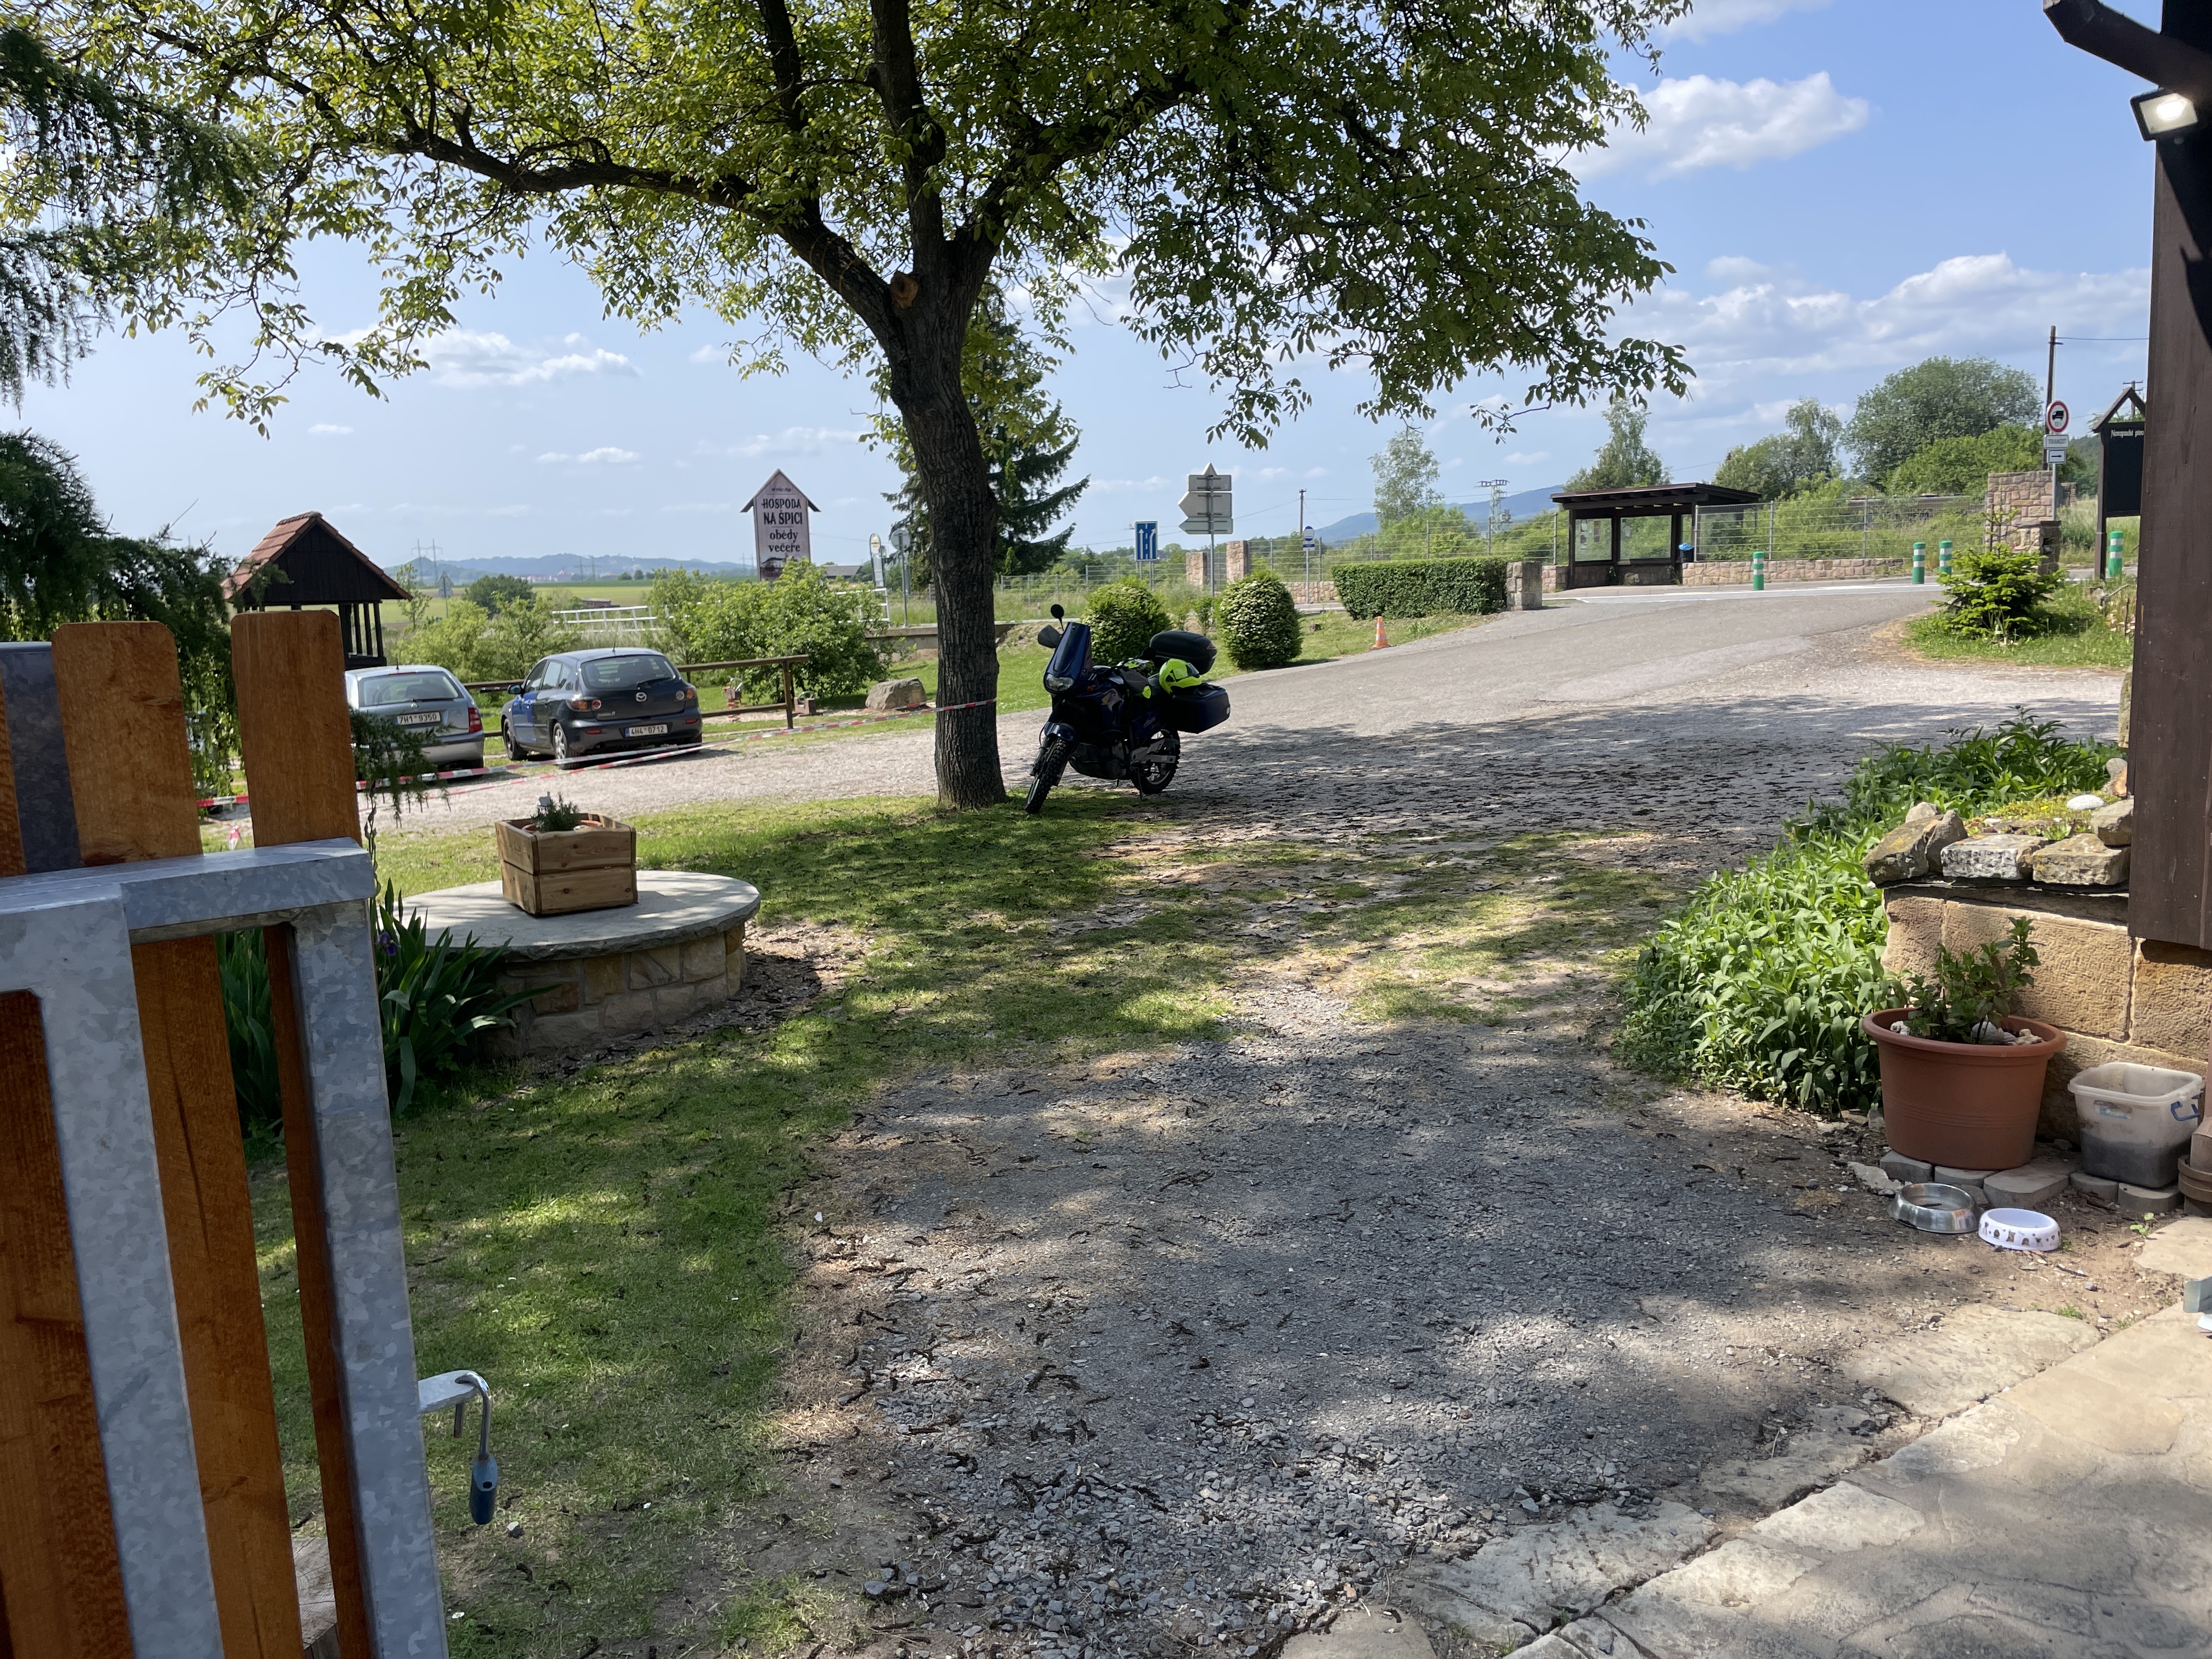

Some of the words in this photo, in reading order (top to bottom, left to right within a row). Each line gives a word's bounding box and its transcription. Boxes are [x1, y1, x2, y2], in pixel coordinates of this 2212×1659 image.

[761, 498, 802, 509] HOSPODA
[764, 512, 776, 524] NA
[778, 510, 803, 524] ŠPICI
[770, 529, 798, 543] obědy
[769, 543, 800, 552] večeře
[399, 715, 413, 724] 7H1
[648, 726, 664, 734] 0712
